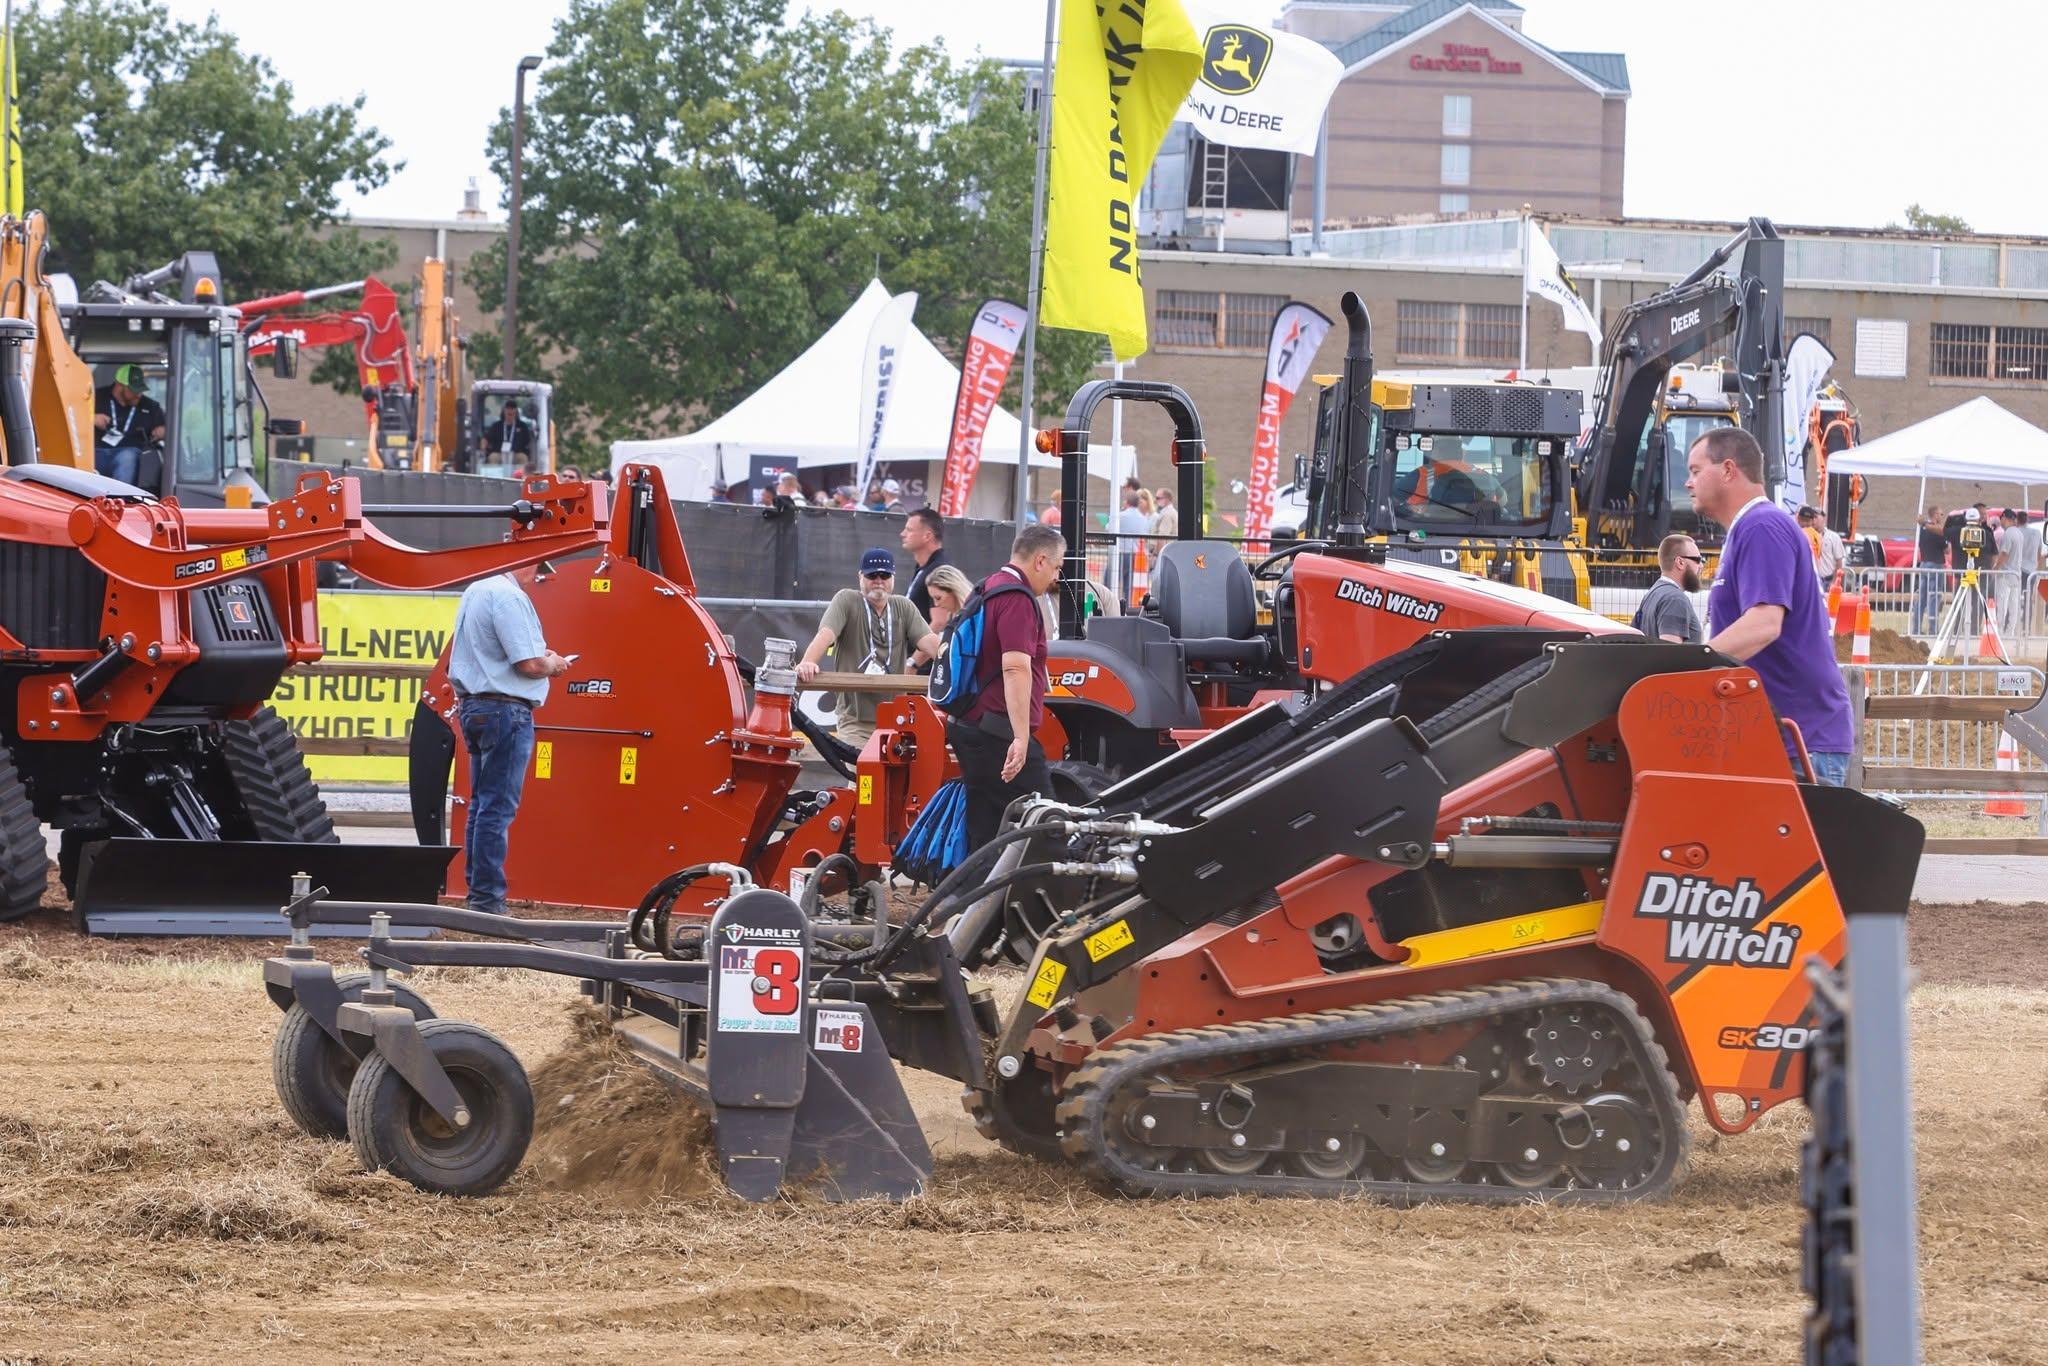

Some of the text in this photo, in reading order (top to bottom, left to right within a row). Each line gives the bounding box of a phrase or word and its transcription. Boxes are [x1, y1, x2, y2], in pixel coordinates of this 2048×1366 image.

[1220, 105, 1283, 131] DEERE
[1671, 309, 1700, 335] DEERE
[176, 559, 216, 579] RC30
[1337, 579, 1383, 607] Ditch
[321, 627, 445, 659] LL-NEW
[274, 675, 420, 704] STRUCTI
[568, 680, 612, 694] MT26
[1639, 876, 1762, 919] Ditch
[743, 927, 801, 938] HARLEY
[1720, 1026, 1823, 1050] SK30
